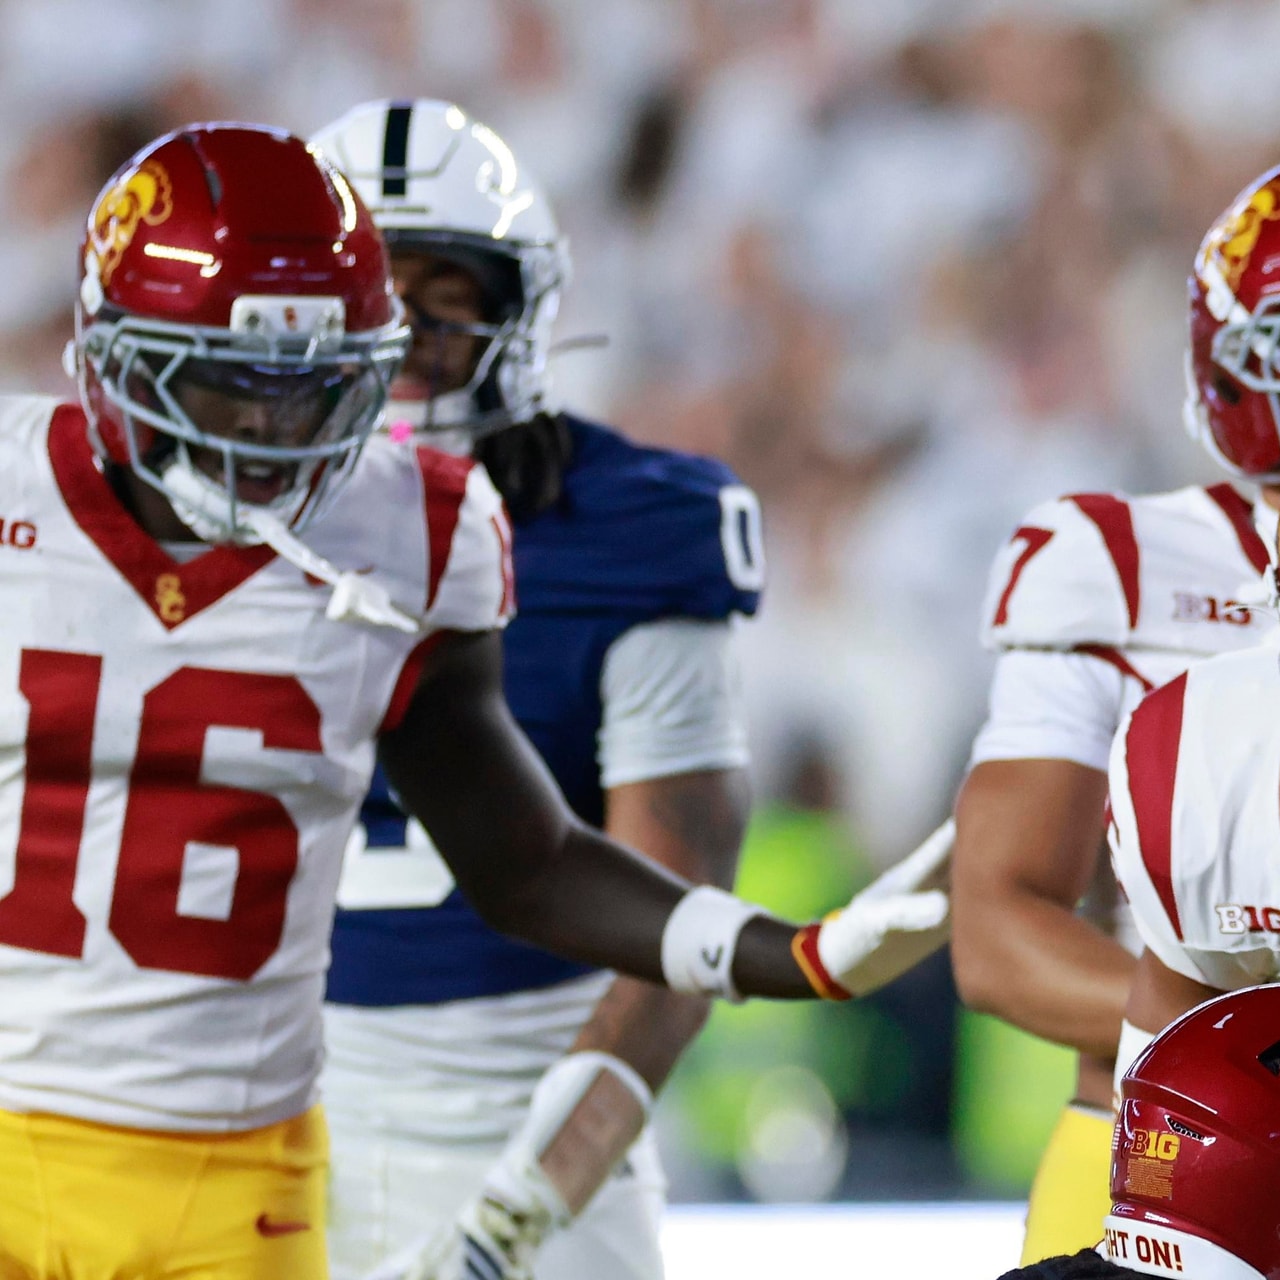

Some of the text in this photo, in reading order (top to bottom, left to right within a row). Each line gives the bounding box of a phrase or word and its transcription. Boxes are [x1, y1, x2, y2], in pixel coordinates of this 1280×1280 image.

[718, 486, 765, 591] 0
[0, 647, 324, 982] 16
[1135, 1234, 1184, 1272] ON!
